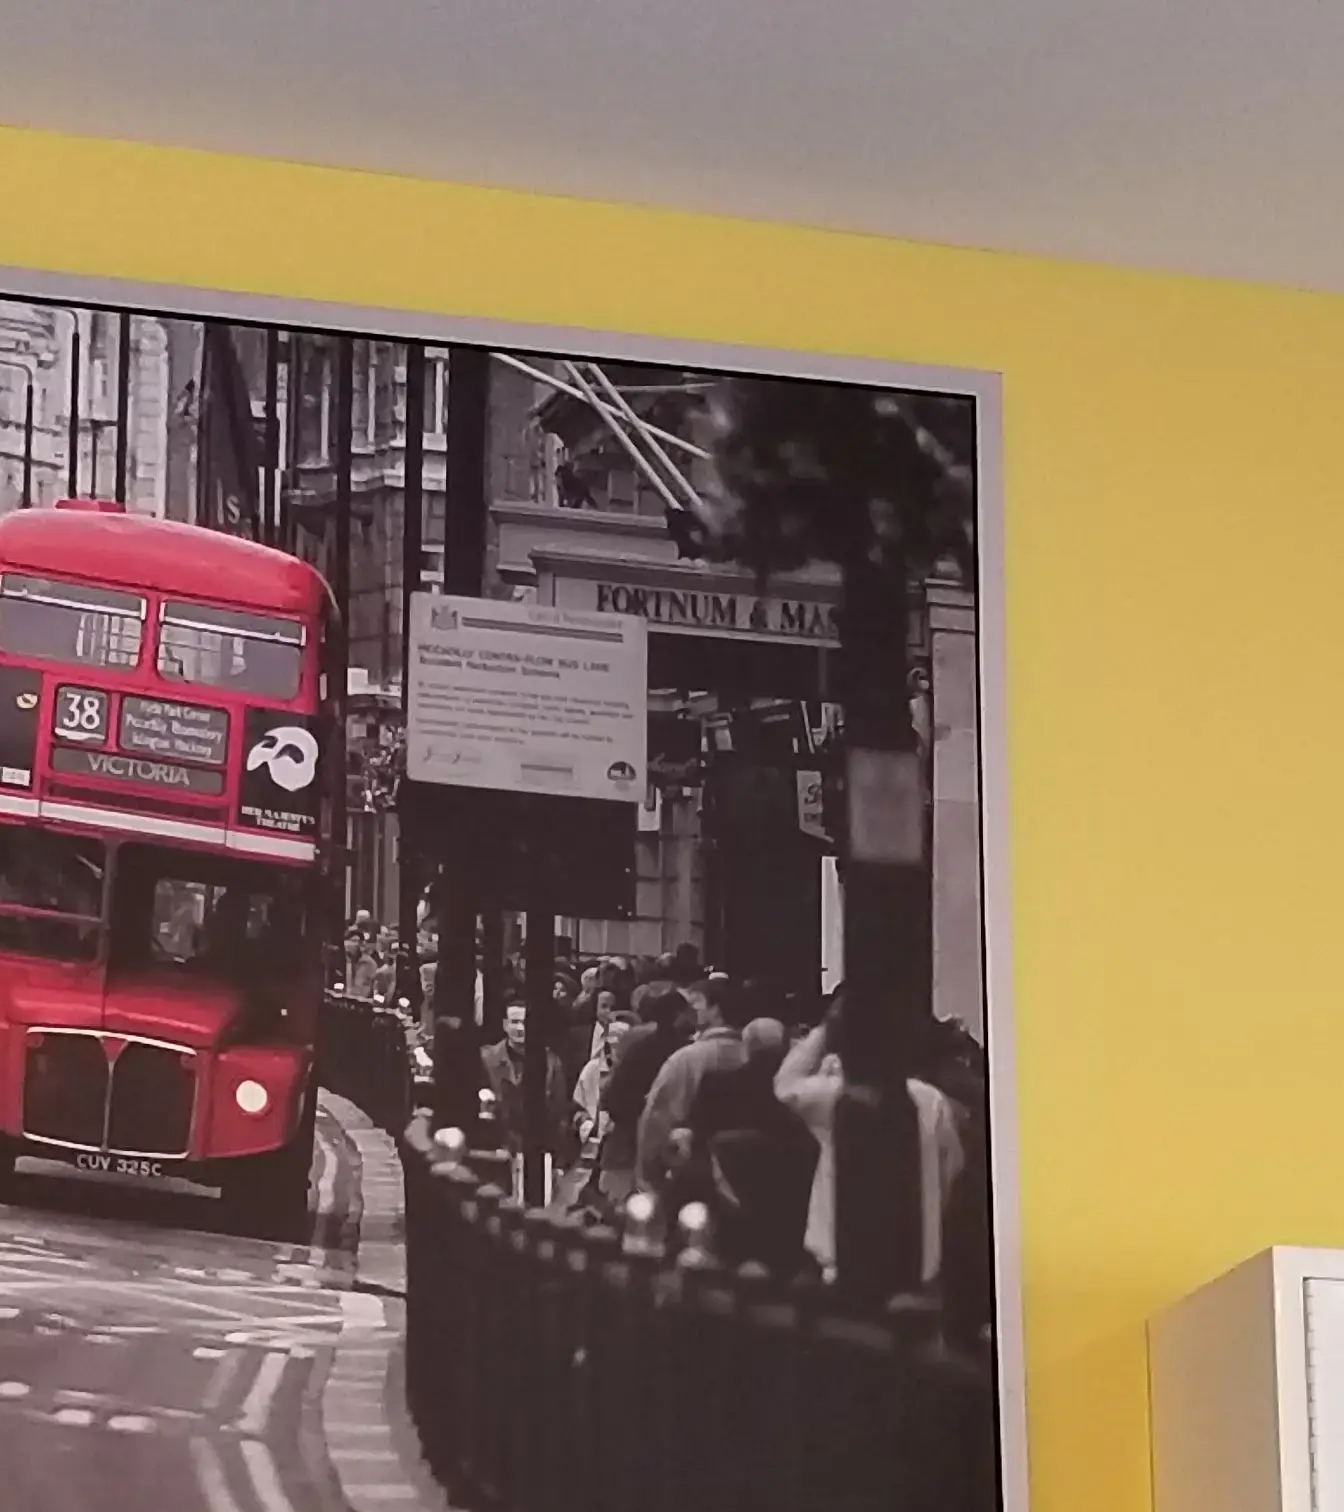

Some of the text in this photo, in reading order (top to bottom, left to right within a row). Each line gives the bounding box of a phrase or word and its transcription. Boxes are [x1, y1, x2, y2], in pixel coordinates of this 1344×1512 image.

[596, 583, 737, 627] FORTNUM
[62, 693, 101, 730] 38
[87, 752, 191, 788] VICTORIA
[76, 1153, 162, 1177] CUV 325C
